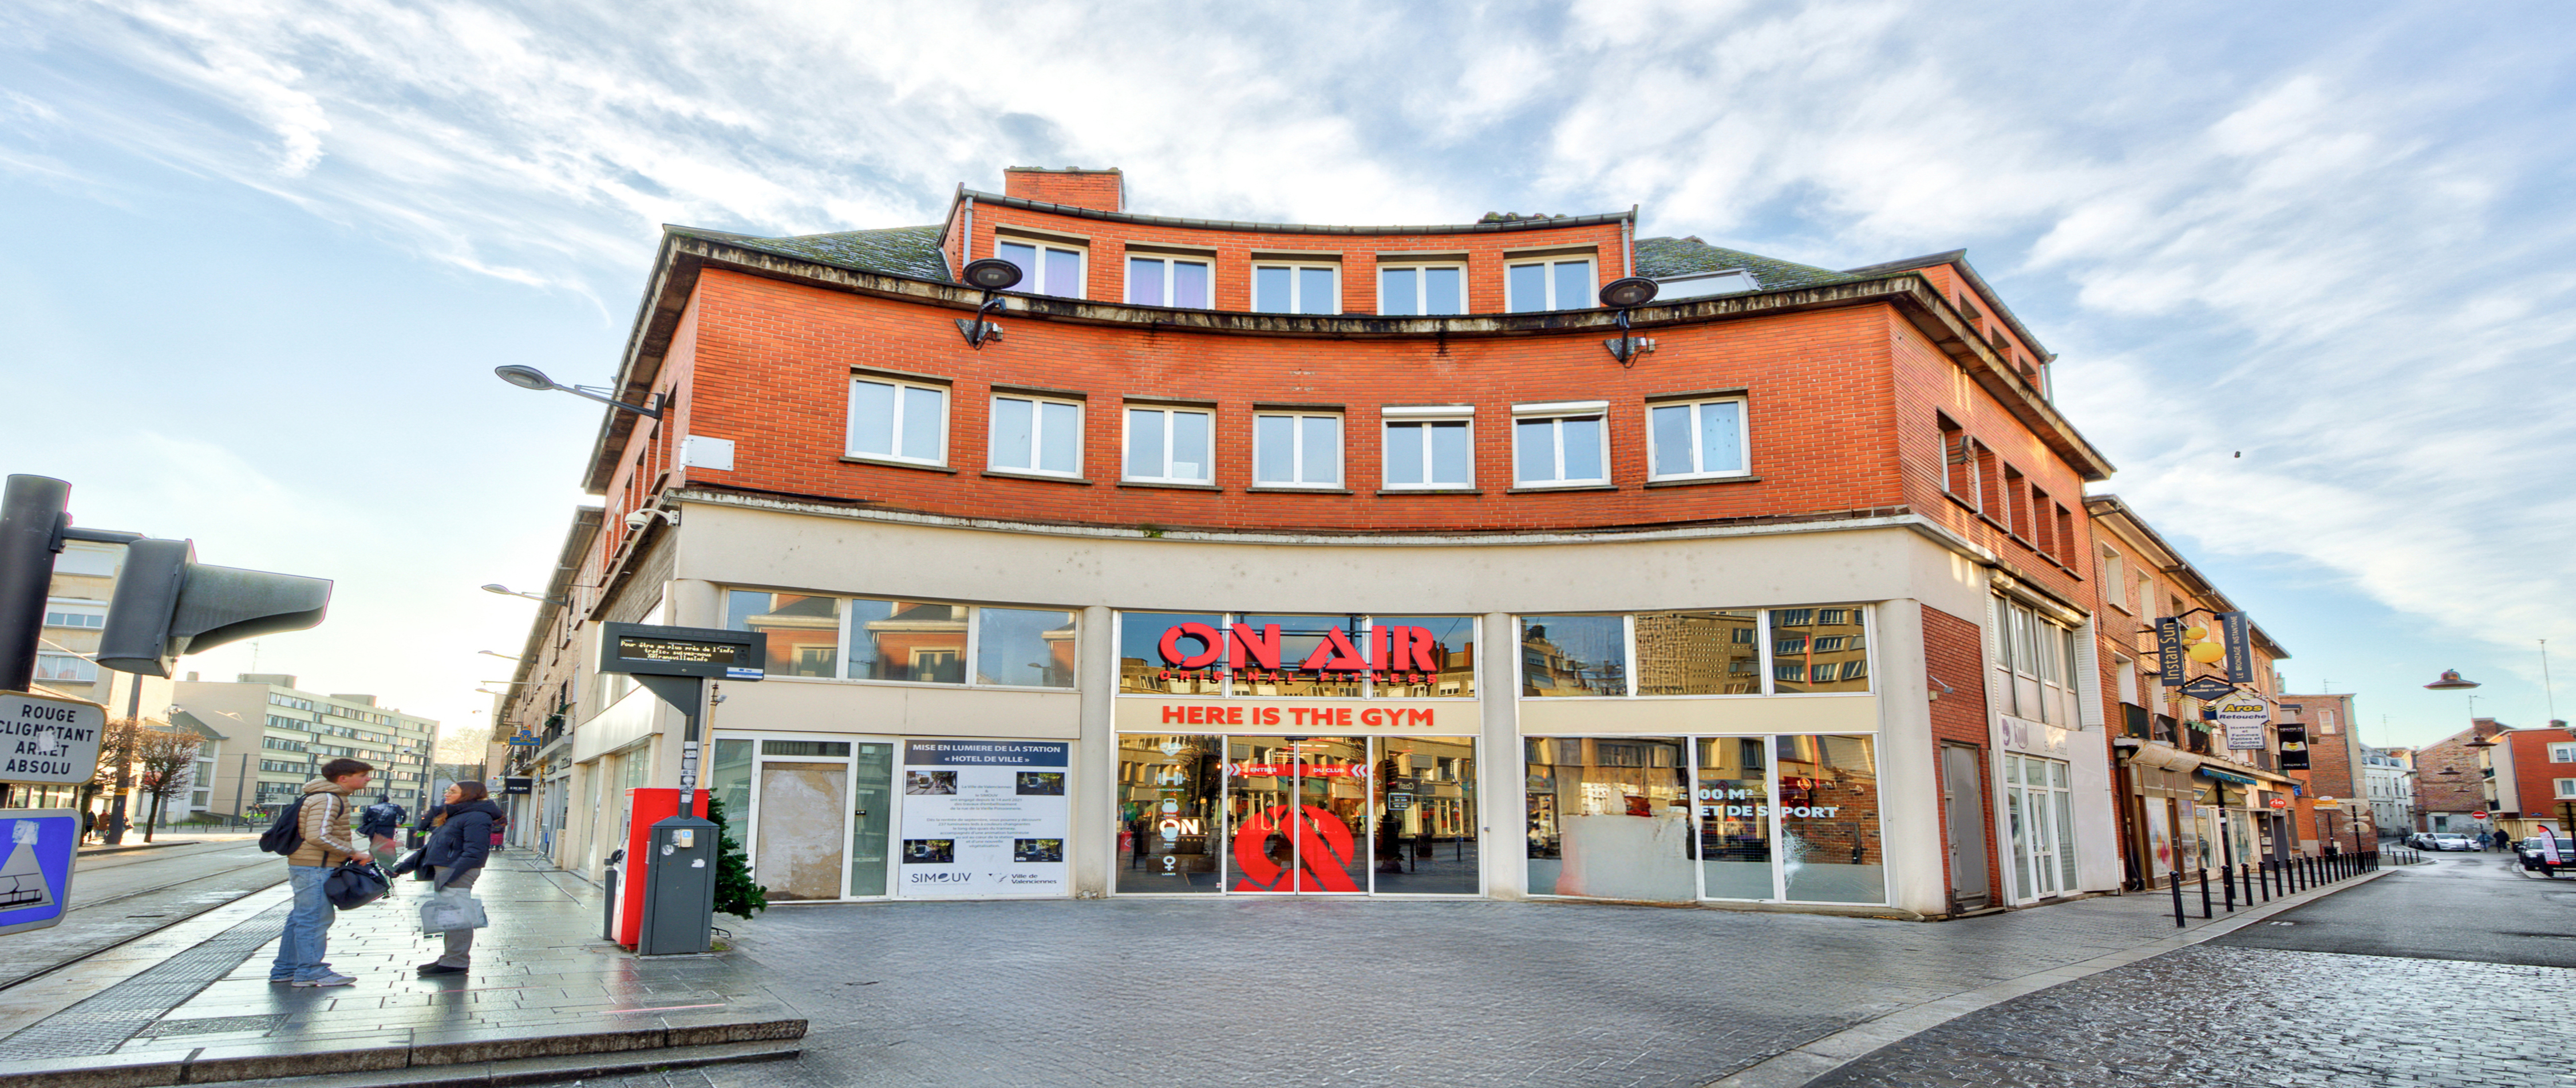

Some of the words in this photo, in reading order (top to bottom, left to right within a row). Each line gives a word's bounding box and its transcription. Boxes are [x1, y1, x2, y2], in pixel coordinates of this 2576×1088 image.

[2159, 622, 2177, 644] Sun
[1159, 622, 1281, 669] ON
[1301, 625, 1437, 671] AIR
[2164, 646, 2180, 680] Instan
[1159, 670, 1297, 681] ORIGINAL
[1320, 672, 1437, 684] FITNESS
[22, 704, 76, 723] ROUGE
[1163, 705, 1243, 724] HERE
[1253, 707, 1280, 725] IS
[1289, 708, 1352, 726] THE
[1361, 708, 1434, 726] GYM
[2222, 704, 2263, 712] Aros
[5, 759, 71, 775] ABSOLU
[1729, 789, 1753, 800] M²
[1726, 805, 1753, 817] DE
[911, 873, 971, 883] SIMOUV
